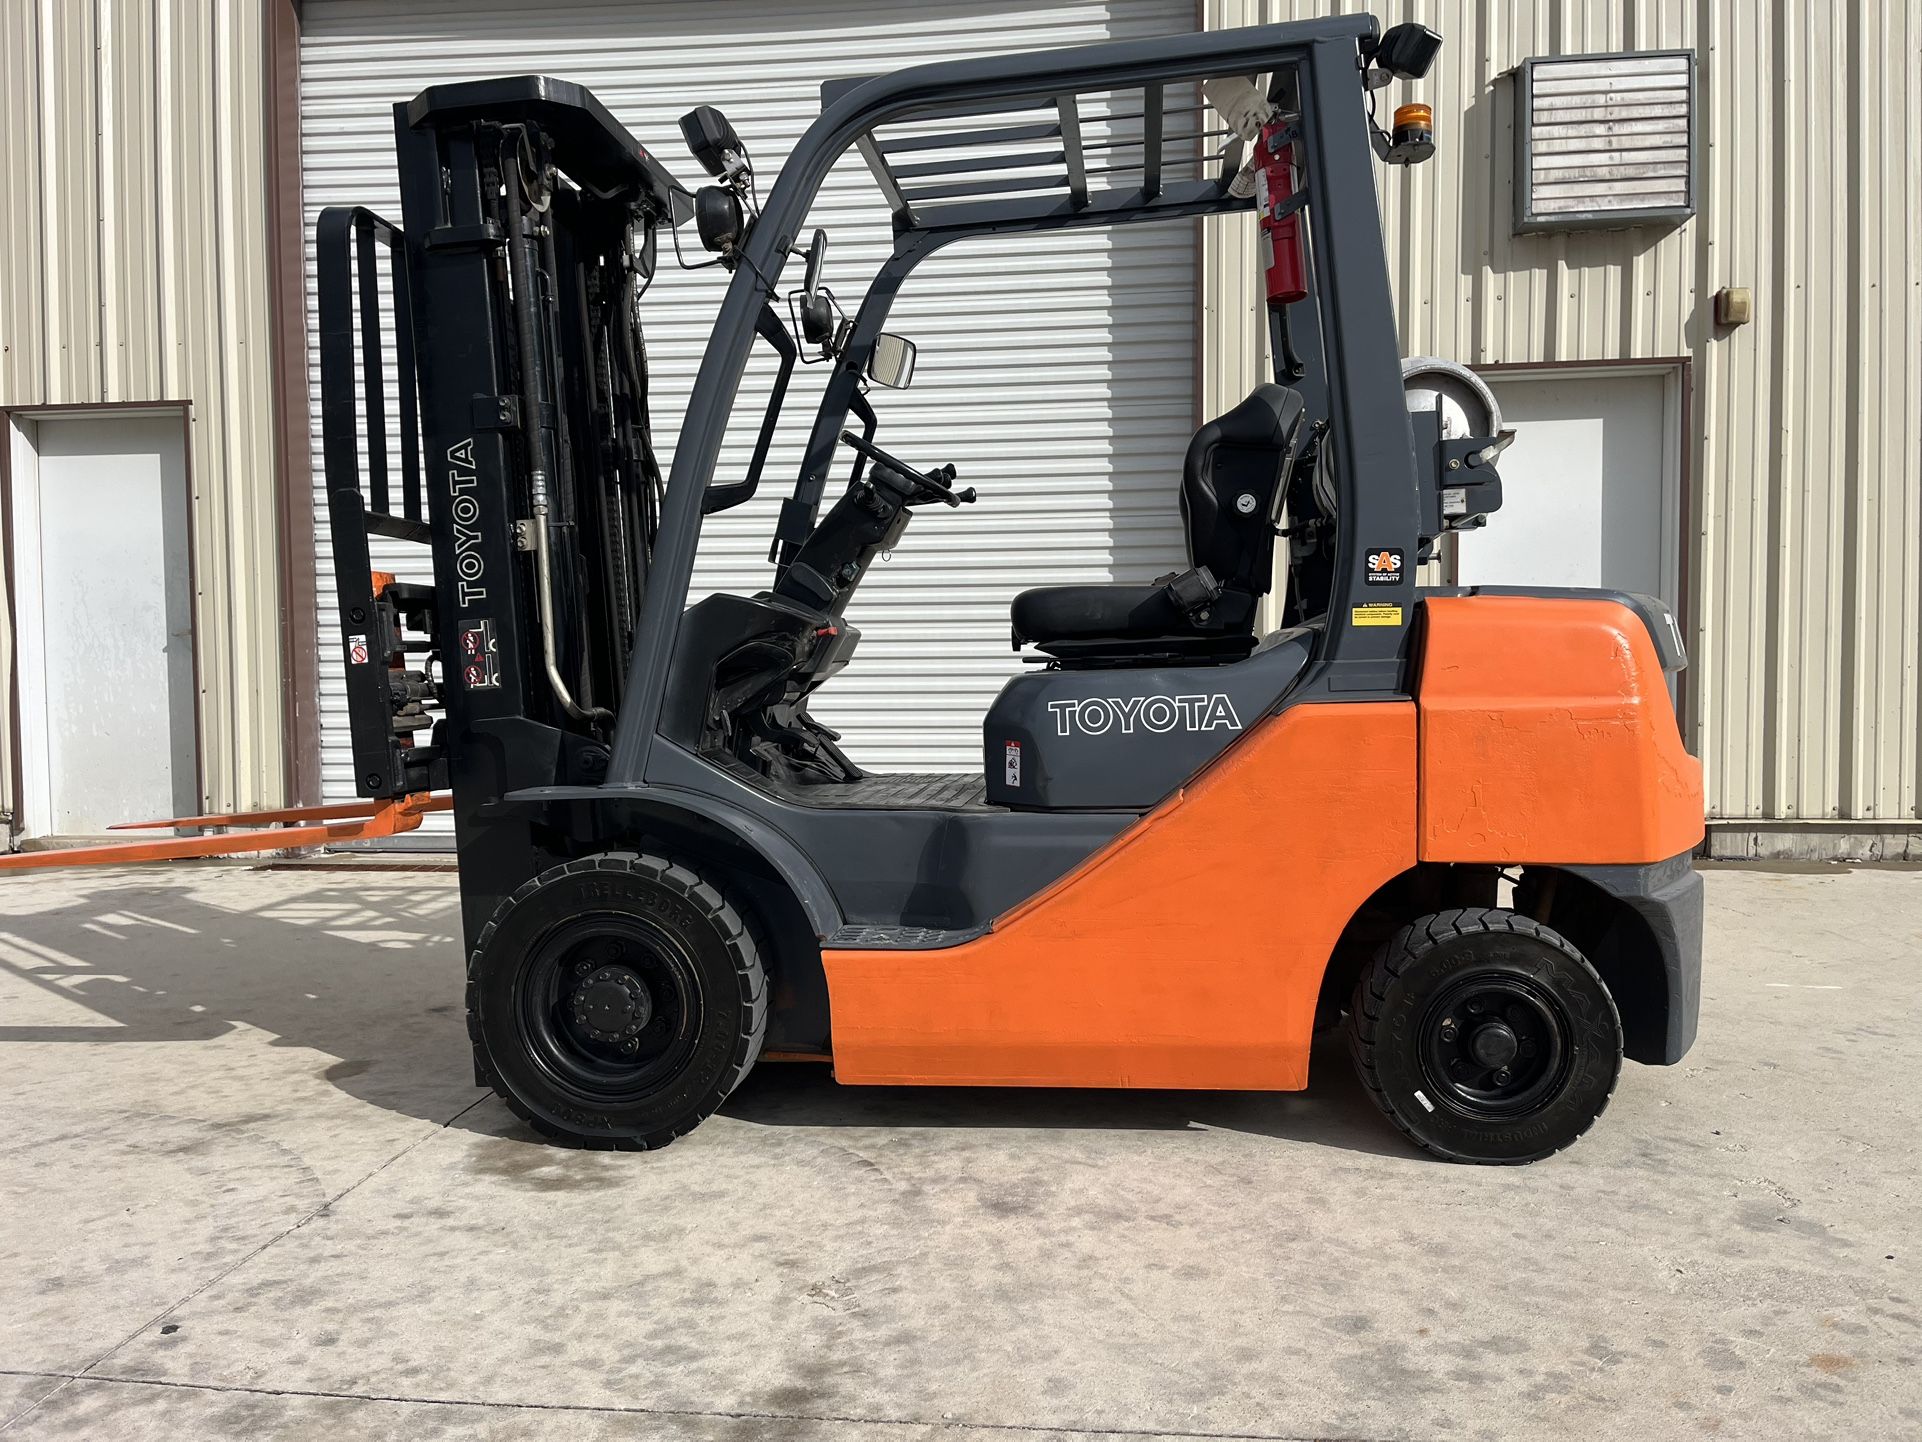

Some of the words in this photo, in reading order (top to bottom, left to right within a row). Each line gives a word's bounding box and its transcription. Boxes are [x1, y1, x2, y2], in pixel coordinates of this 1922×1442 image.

[447, 437, 487, 608] TOYOTA
[1367, 551, 1402, 572] SAS
[1047, 693, 1243, 736] TOYOTA
